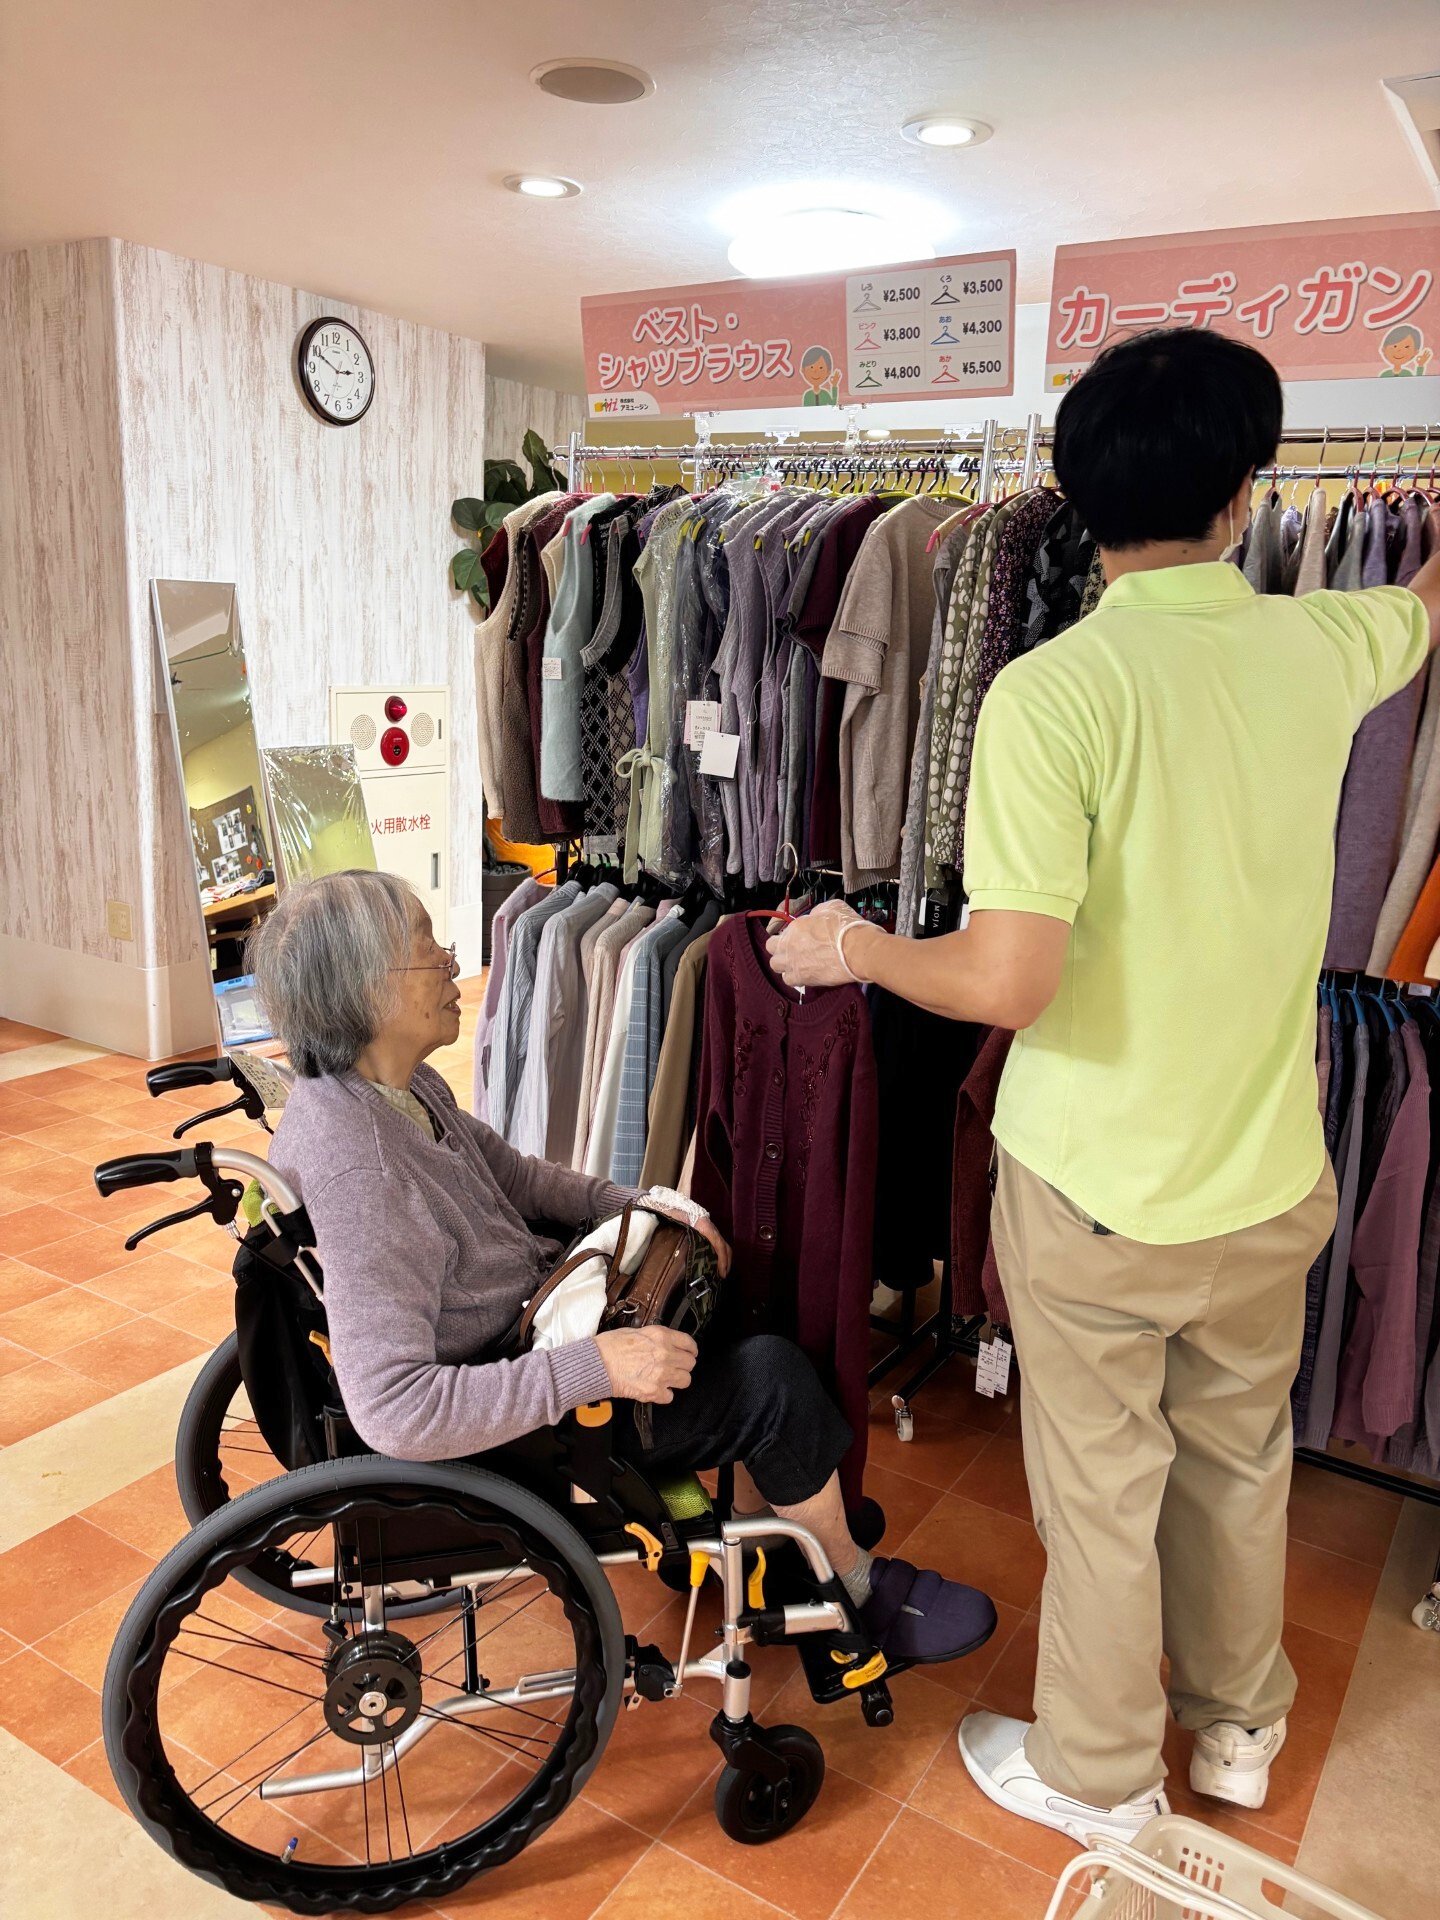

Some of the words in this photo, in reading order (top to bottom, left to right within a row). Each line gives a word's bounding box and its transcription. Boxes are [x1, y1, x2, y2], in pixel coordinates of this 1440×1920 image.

[940, 275, 952, 283] くろ
[963, 279, 1003, 294] ¥3,500
[883, 287, 921, 302] ¥2,500
[1057, 261, 1433, 349] カーディガン
[858, 322, 876, 331] ピンク
[962, 319, 1003, 335] ¥4,300
[321, 333, 329, 347] 11
[332, 332, 341, 345] 12
[884, 327, 921, 341] ¥3,800
[312, 344, 321, 358] 10
[353, 353, 360, 366] 2
[598, 338, 794, 390] シャツブラウス
[859, 360, 877, 368] みどり
[939, 355, 952, 363] あか
[308, 361, 316, 374] 9
[884, 366, 921, 379] ¥4,800
[962, 360, 1002, 375] ¥5,500
[358, 371, 364, 384] 3
[313, 380, 321, 392] 8
[323, 394, 330, 406] 7
[353, 388, 361, 400] 4
[334, 400, 342, 412] 6
[346, 398, 353, 410] 5
